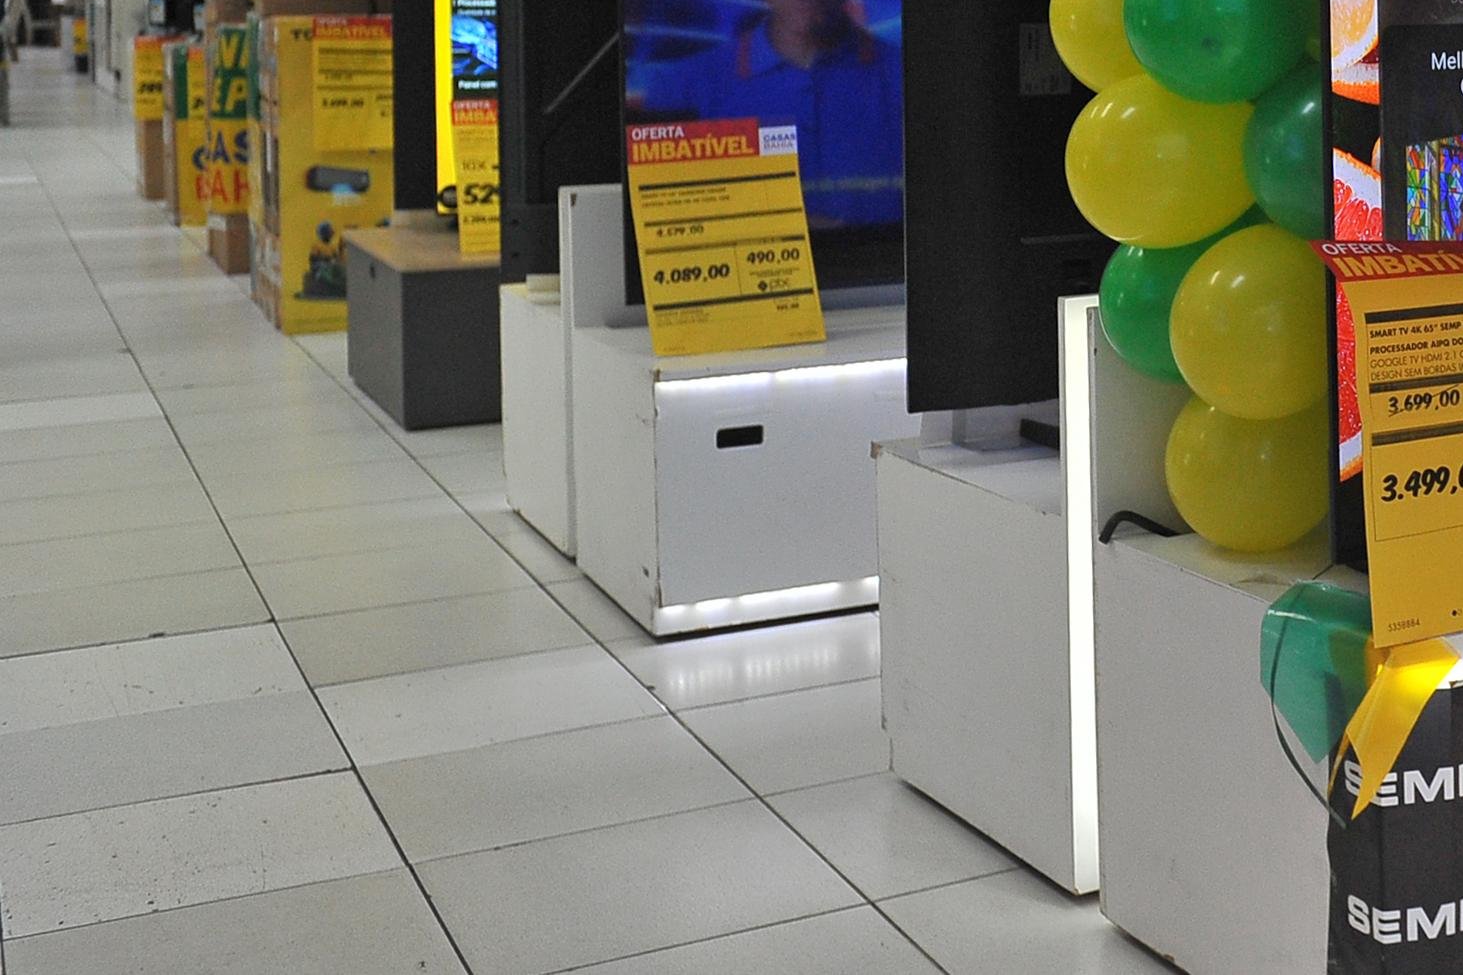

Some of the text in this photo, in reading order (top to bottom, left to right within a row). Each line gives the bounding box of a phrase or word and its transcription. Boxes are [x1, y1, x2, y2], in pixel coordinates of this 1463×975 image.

[631, 125, 685, 141] OFERTA
[763, 133, 795, 142] CASAS
[632, 133, 754, 163] IMBATÍVEL
[747, 248, 800, 265] 490,00
[1321, 242, 1402, 256] OFERTA
[653, 263, 731, 285] 4.089,00
[1369, 327, 1398, 339] SMART
[1398, 327, 1408, 335] TV
[1411, 326, 1422, 334] 4K
[1440, 322, 1461, 331] SEMP
[1370, 341, 1428, 355] PROCESSADOR
[1431, 339, 1450, 348] AIPQ
[1370, 356, 1408, 369] GOOGLE
[1409, 355, 1419, 364] TV
[1421, 353, 1442, 364] HDMI
[1443, 350, 1456, 361] 2.1
[1370, 369, 1403, 382] DESIGN
[1404, 367, 1422, 377] SEM
[1423, 363, 1457, 375] BORDAS
[1388, 388, 1461, 415] 3.699,00
